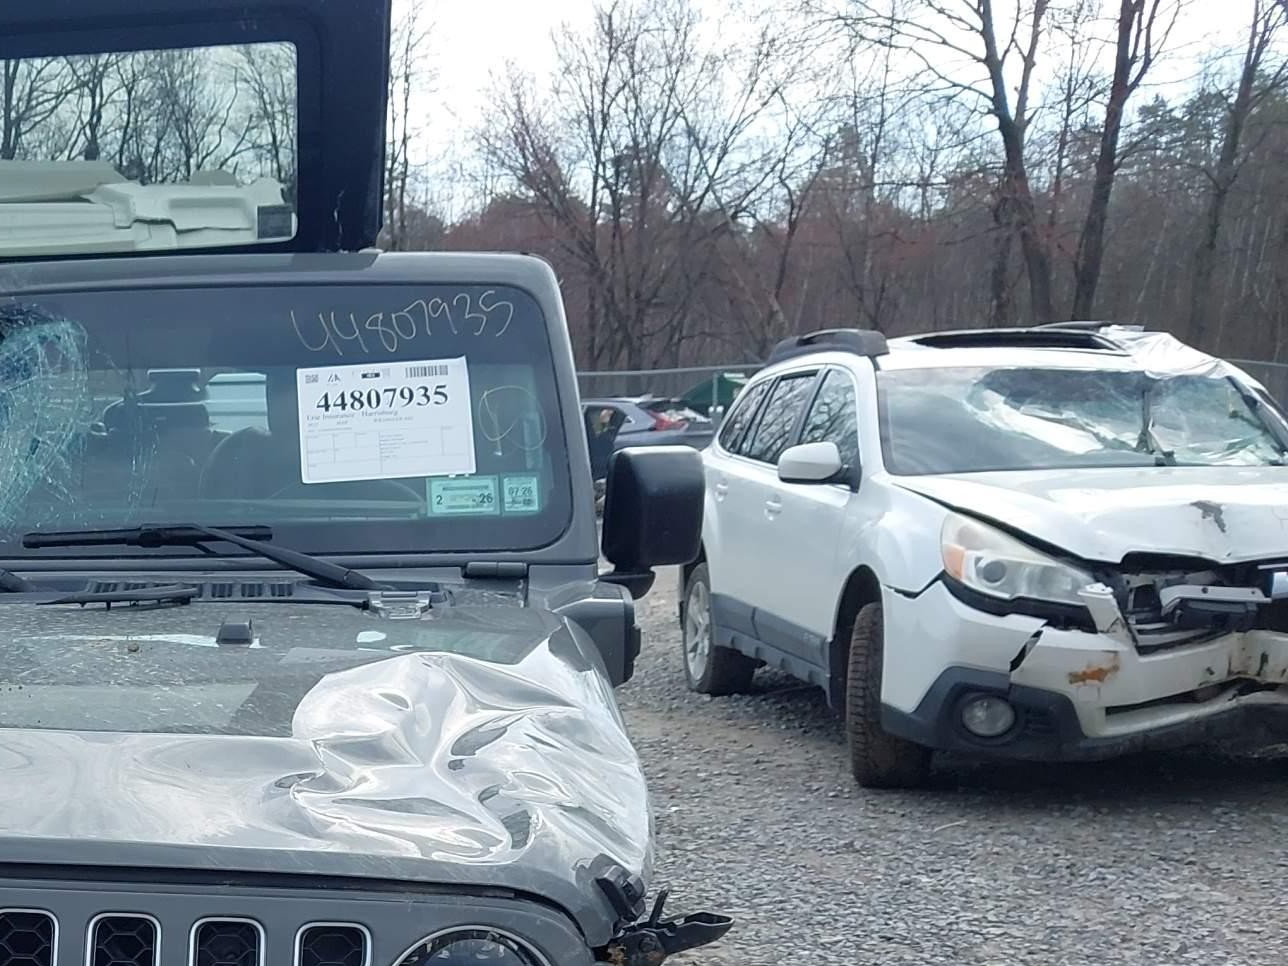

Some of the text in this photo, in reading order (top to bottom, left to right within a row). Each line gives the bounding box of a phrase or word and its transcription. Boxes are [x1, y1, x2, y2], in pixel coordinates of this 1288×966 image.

[290, 290, 513, 356] 44807935
[316, 384, 449, 412] 44807935
[435, 494, 443, 505] 2
